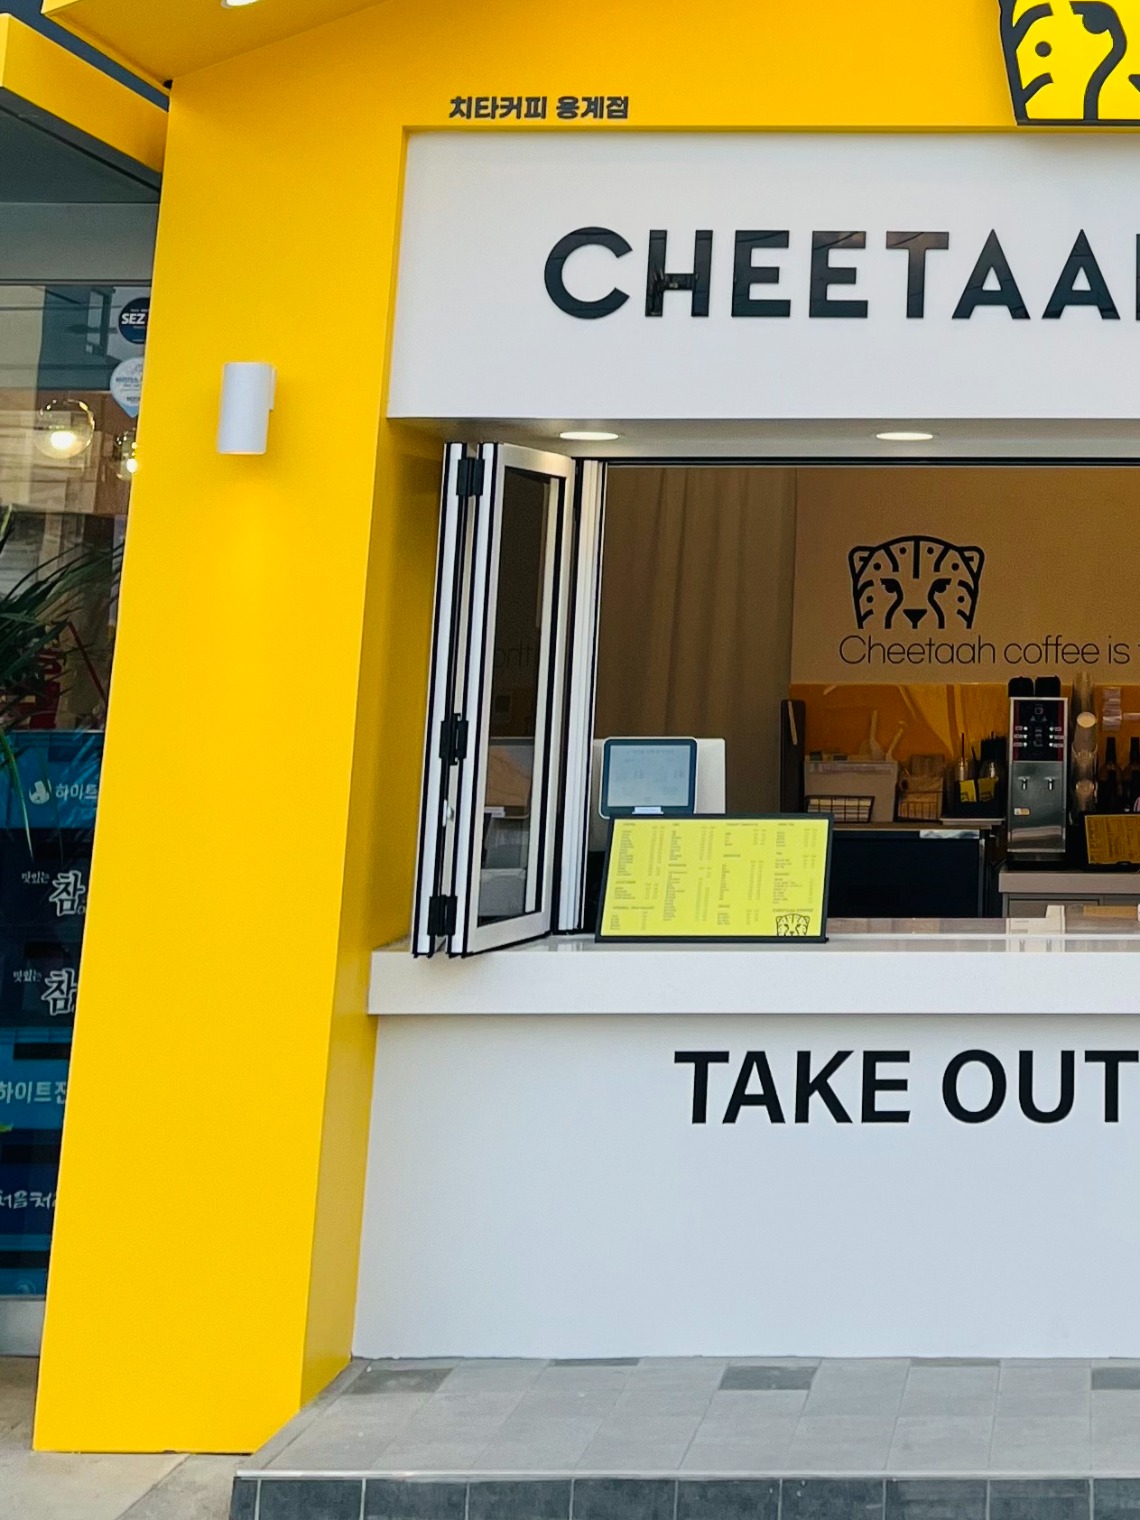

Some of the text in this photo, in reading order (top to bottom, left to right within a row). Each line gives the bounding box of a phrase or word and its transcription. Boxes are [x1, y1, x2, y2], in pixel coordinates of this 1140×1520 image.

[449, 96, 629, 119] 치타커피 용계점
[839, 635, 996, 665] Cheetaah
[1003, 635, 1100, 665] coffee
[1107, 636, 1131, 666] is
[673, 1049, 1139, 1124] TAKE OUT
